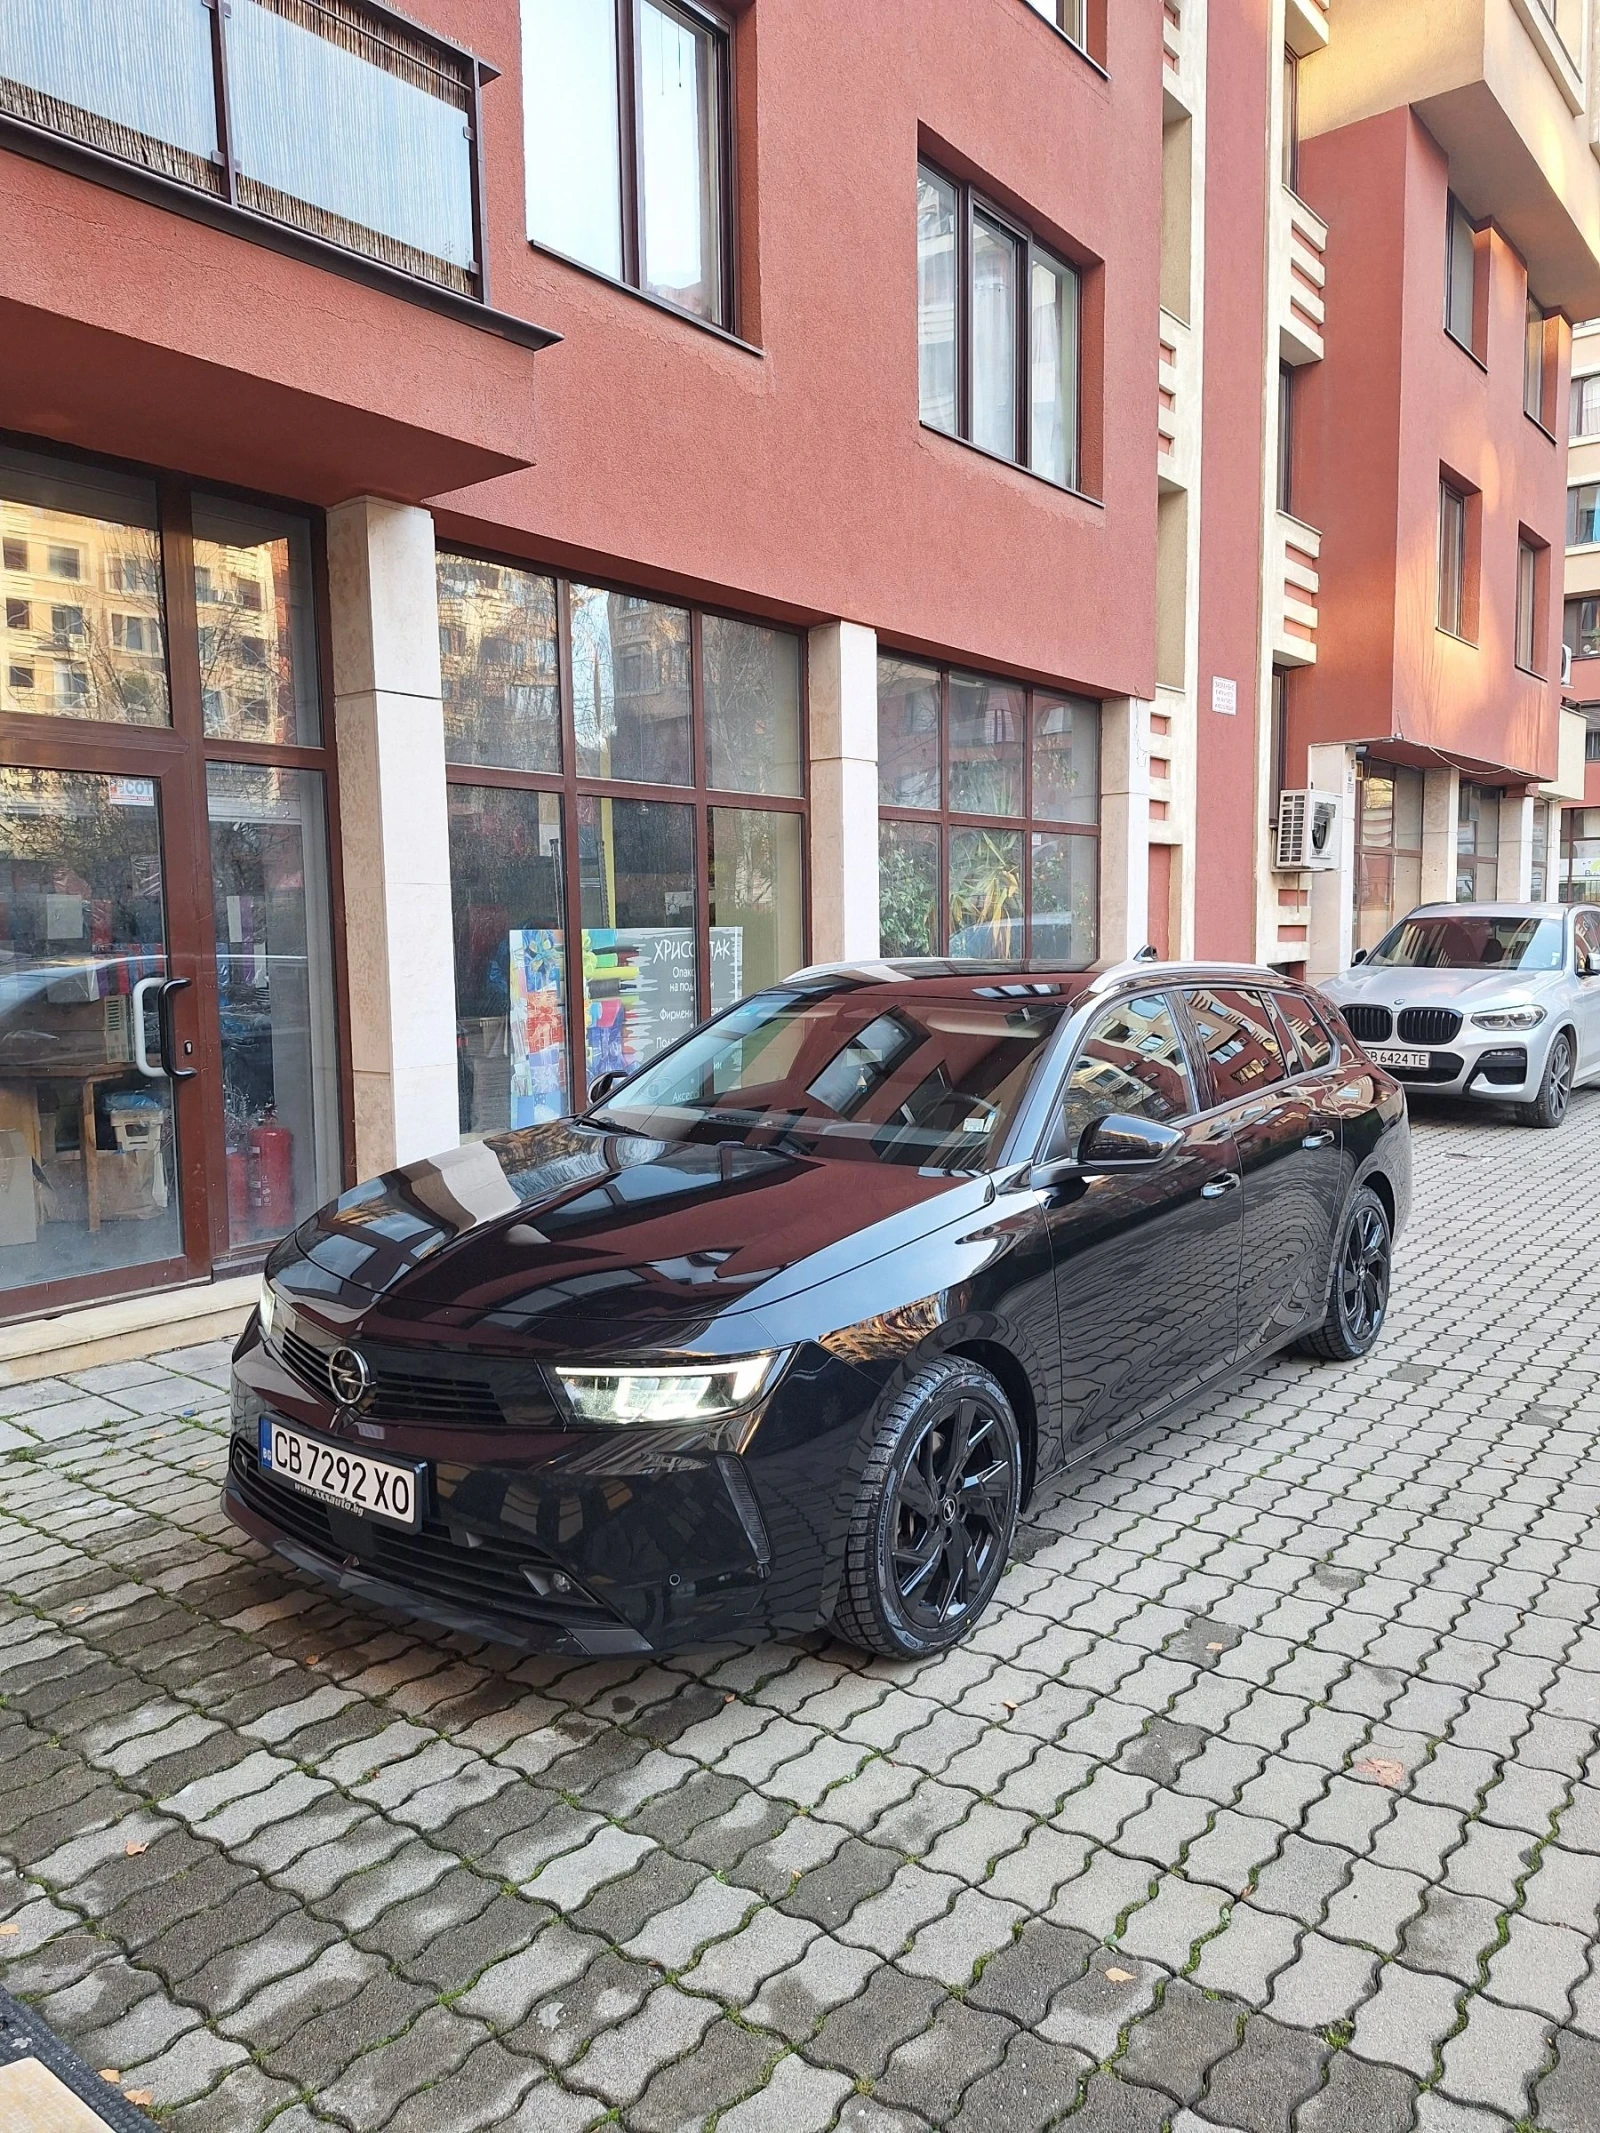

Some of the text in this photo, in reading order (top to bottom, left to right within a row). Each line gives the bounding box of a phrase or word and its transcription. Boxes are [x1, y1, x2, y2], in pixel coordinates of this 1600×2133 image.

[1380, 1052, 1409, 1065] 6424
[1411, 1054, 1427, 1066] TE
[262, 1447, 272, 1461] BG
[275, 1431, 410, 1515] CB 7292 XO
[294, 1482, 365, 1517] www.xxxauto.bg
